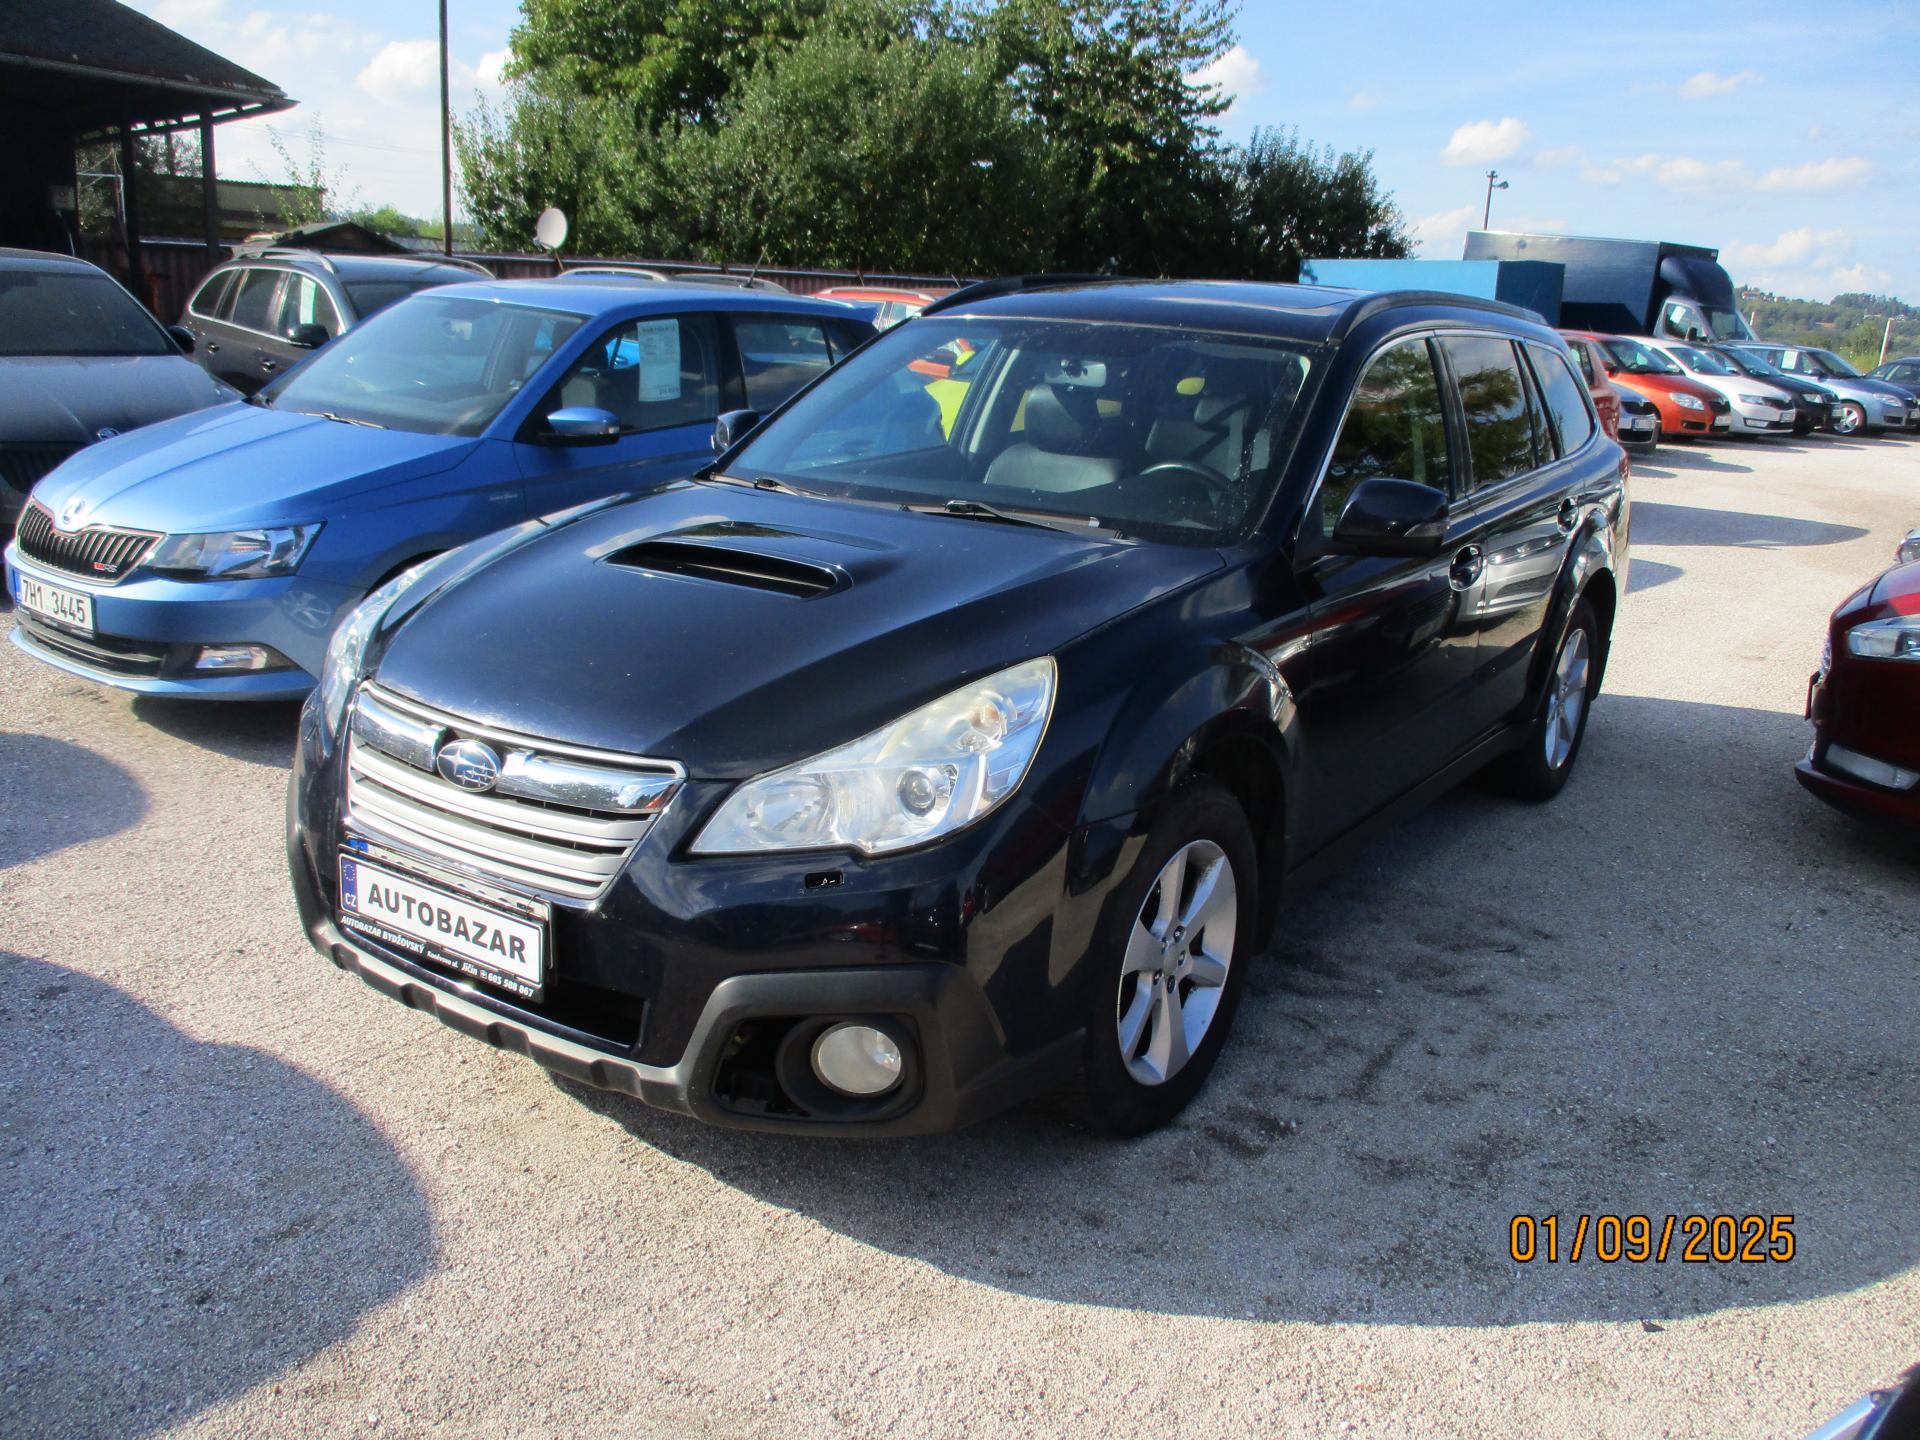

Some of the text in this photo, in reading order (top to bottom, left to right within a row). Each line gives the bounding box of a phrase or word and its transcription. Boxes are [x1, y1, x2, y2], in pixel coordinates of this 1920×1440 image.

[22, 579, 85, 623] 7H1 3445
[345, 892, 357, 908] CZ
[341, 915, 382, 937] AUTOBAZAR
[382, 931, 425, 953] BYDŽOVSKÝ
[368, 883, 526, 963] AUTOBAZAR
